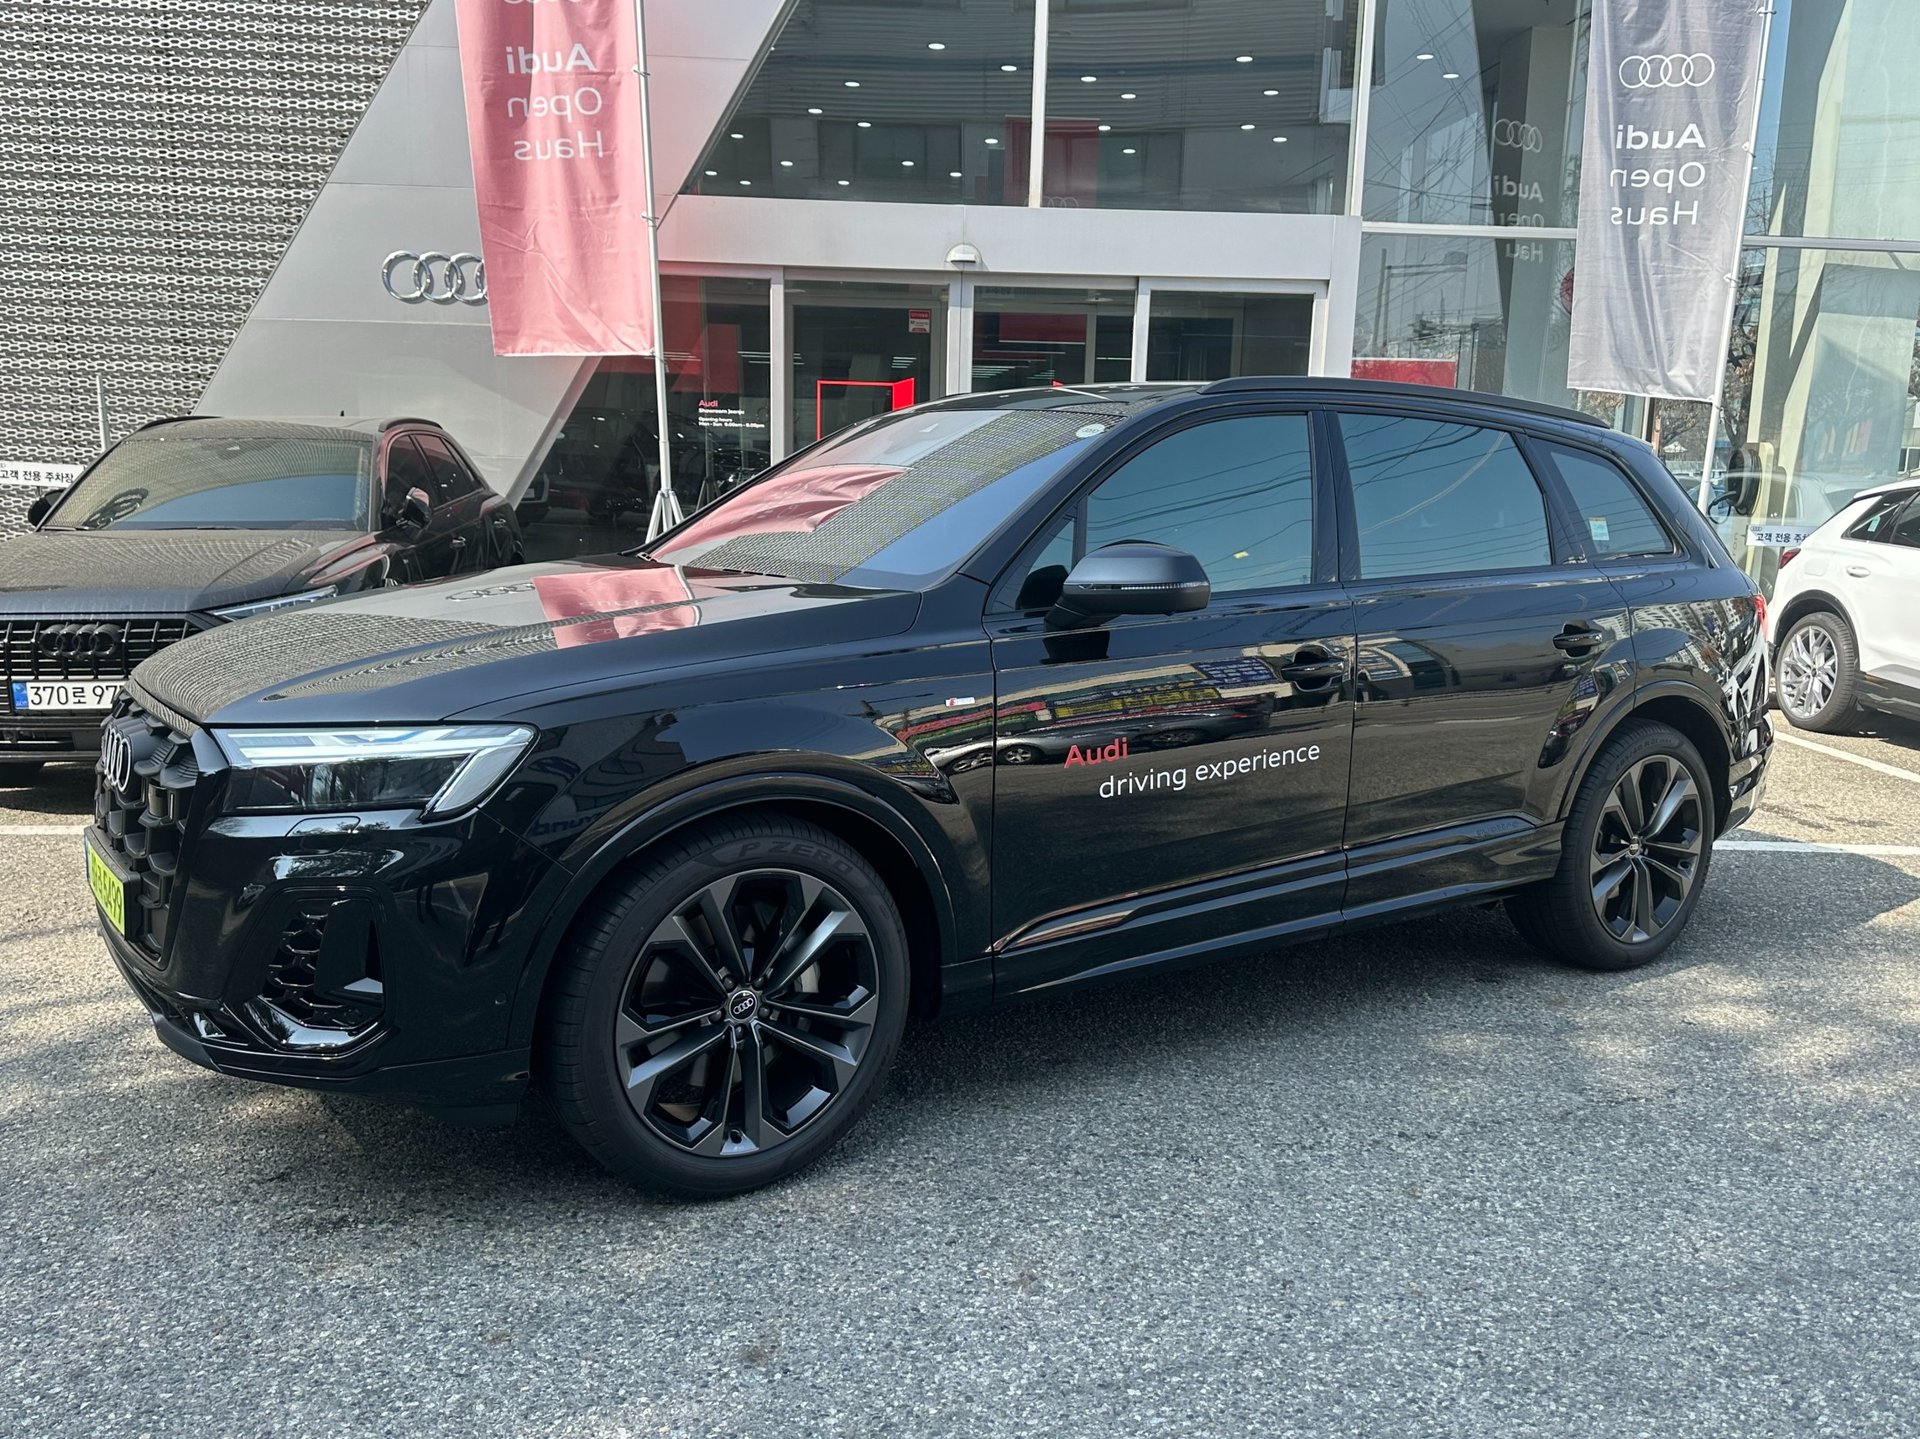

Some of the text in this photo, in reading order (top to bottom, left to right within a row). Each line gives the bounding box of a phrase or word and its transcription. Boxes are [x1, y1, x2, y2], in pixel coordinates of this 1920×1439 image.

[0, 469, 74, 484] 고객 전용 주차장
[1756, 532, 1773, 543] 고객
[1775, 532, 1791, 544] 전용
[30, 685, 123, 705] 370로 97
[1064, 737, 1129, 769] Audi
[1099, 744, 1321, 798] driving experience
